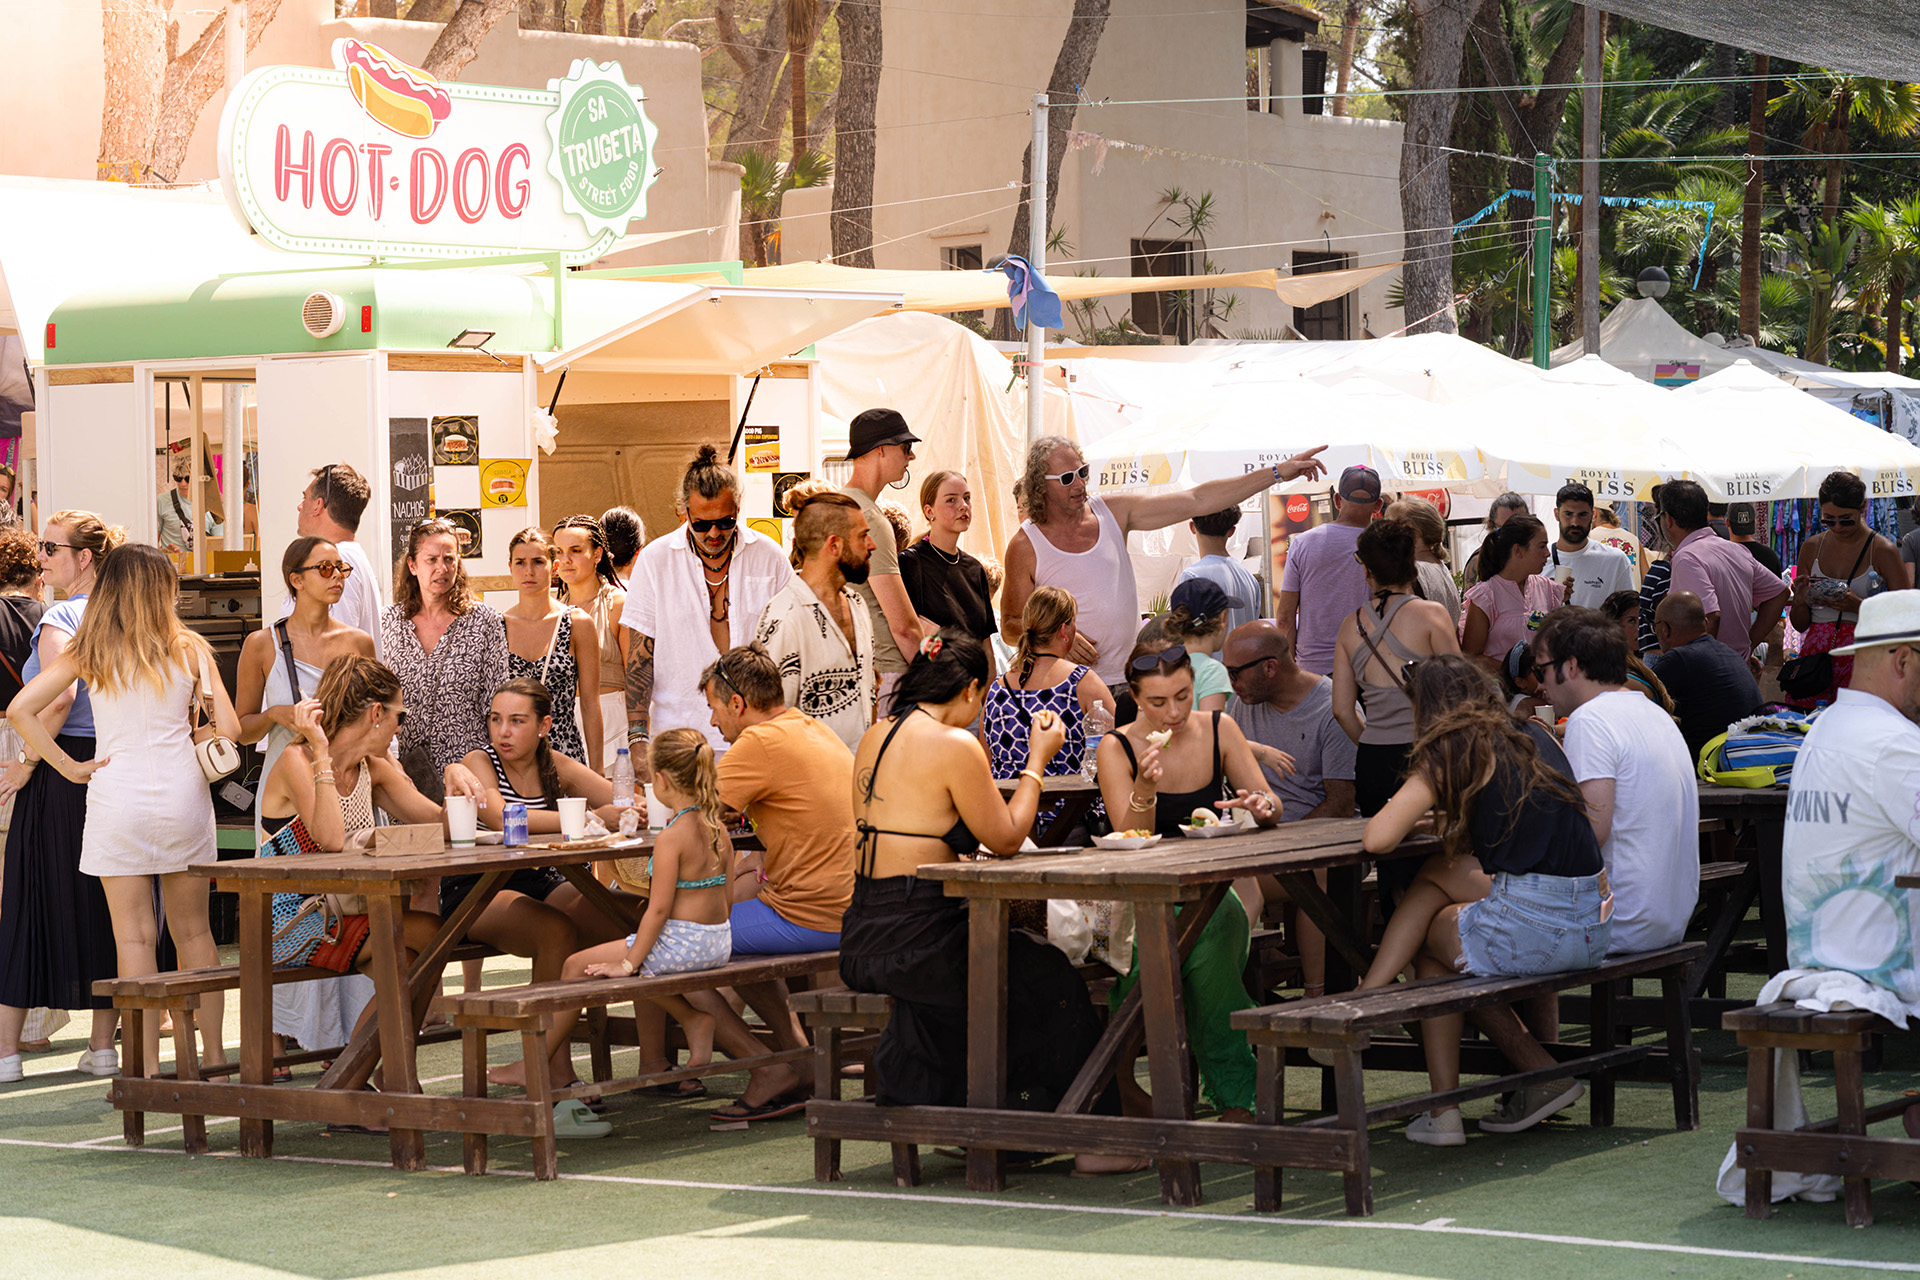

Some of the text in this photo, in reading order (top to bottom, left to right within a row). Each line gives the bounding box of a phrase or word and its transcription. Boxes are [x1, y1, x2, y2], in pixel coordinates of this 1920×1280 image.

[588, 95, 609, 122] SA
[562, 122, 644, 177] TRUGETA
[274, 123, 531, 225] HOT DOG
[579, 160, 639, 206] STREET FOOD
[1411, 452, 1434, 461] ROYAL
[1111, 461, 1139, 471] ROYAL
[1403, 461, 1444, 476] BLISS
[1099, 469, 1150, 486] BLISS
[1580, 470, 1618, 479] ROYAL
[1735, 472, 1760, 480] ROYAL
[1880, 471, 1903, 479] ROYAL
[1727, 480, 1771, 496] BLISS
[1872, 479, 1914, 494] BLISS
[392, 500, 425, 518] NACHOS
